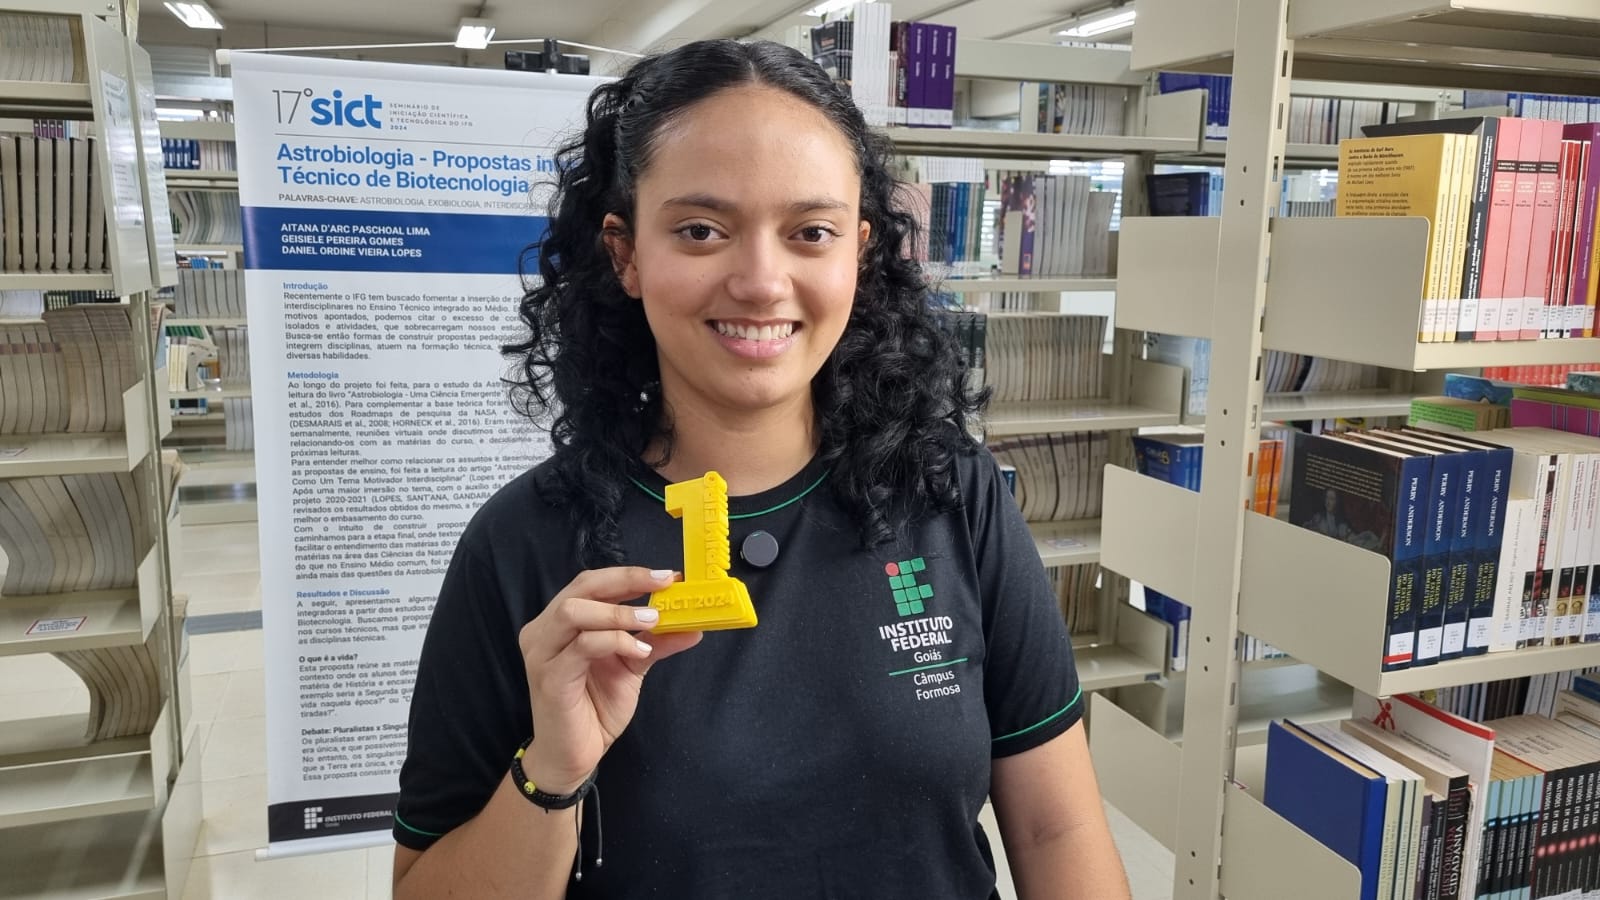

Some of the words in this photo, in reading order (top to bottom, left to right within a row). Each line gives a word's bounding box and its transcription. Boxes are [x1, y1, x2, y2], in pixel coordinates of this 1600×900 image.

[310, 89, 383, 129] sict
[389, 109, 426, 118] INICIAÇÃO
[429, 111, 468, 119] CIENTÍFICA
[276, 142, 413, 170] Astrobiologia
[433, 150, 531, 173] Propostas
[277, 165, 360, 187] Técnico
[366, 167, 390, 187] de
[396, 170, 530, 197] Biotecnologia
[278, 193, 359, 203] PALAVRAS-CHAVE:
[280, 223, 319, 232] AITANA
[320, 224, 350, 233] D'ARC
[352, 225, 404, 235] PASCHOAL
[406, 226, 430, 235] LIMA
[281, 234, 324, 244] GEISIELE
[326, 235, 367, 245] PEREIRA
[369, 236, 403, 246] GOMES
[281, 245, 317, 254] DANIEL
[319, 246, 355, 255] ORDINE
[357, 247, 389, 256] VIEIRA
[391, 248, 422, 257] LOPES
[282, 281, 328, 291] Introdução
[283, 291, 343, 300] Recentemente
[352, 292, 366, 301] IFG
[385, 293, 420, 301] buscado
[422, 293, 457, 302] fomentar
[467, 295, 500, 303] inserção
[283, 302, 354, 311] interdisciplinares
[369, 303, 396, 311] Ensino
[398, 303, 430, 311] Técnico
[432, 304, 470, 313] integrado
[484, 304, 509, 312] Médio.
[284, 311, 317, 320] motivos
[324, 312, 368, 321] apontados,
[374, 313, 411, 322] podemos
[417, 313, 434, 321] citar
[284, 321, 320, 329] isolados
[336, 322, 378, 330] atividades,
[404, 323, 463, 332] sobrecarregam
[285, 331, 323, 339] Busca-se
[326, 331, 350, 340] então
[353, 332, 382, 340] formas
[385, 332, 395, 340] de
[285, 341, 322, 351] integrem
[327, 341, 372, 351] disciplinas,
[421, 342, 459, 351] formação
[286, 351, 320, 359] diversas
[322, 351, 370, 359] habilidades.
[287, 371, 339, 380] Metodologia
[1409, 477, 1418, 501] PERRY
[1440, 473, 1448, 496] PERRY
[1466, 470, 1474, 493] PERRY
[1493, 469, 1502, 492] PERRY
[1406, 504, 1415, 546] ANDERSON
[1435, 499, 1445, 541] ANDERSON
[1461, 496, 1471, 538] ANDERSON
[1488, 496, 1498, 536] ANDERSON
[704, 471, 727, 583] PRIMEIRO
[296, 589, 340, 598] Resultados
[349, 588, 389, 596] Discussão
[655, 595, 690, 612] SICT
[694, 592, 736, 609] 2024
[879, 615, 953, 640] INSTITUTO
[891, 631, 952, 652] FEDERAL
[298, 655, 305, 663] O
[337, 653, 358, 661] vida?
[913, 648, 942, 664] Goiás
[298, 664, 317, 672] Esta
[319, 663, 354, 672] proposta
[356, 661, 378, 669] reúne
[913, 669, 955, 687] Câmpus
[916, 683, 961, 701] Formosa
[301, 727, 331, 735] Debate:
[332, 724, 374, 733] Pluralistas
[1544, 782, 1552, 810] MULTIDÕES
[1554, 779, 1563, 808] MULTIDÕES
[1566, 777, 1574, 806] MULTIDÕES
[1576, 775, 1584, 803] MULTIDÕES
[1585, 773, 1594, 802] MULTIDÕES
[325, 812, 361, 822] INSTITUTO
[363, 809, 392, 818] FEDERAL
[1553, 810, 1559, 818] EM
[1574, 806, 1579, 814] EM
[1450, 825, 1463, 895] CIDADANIA
